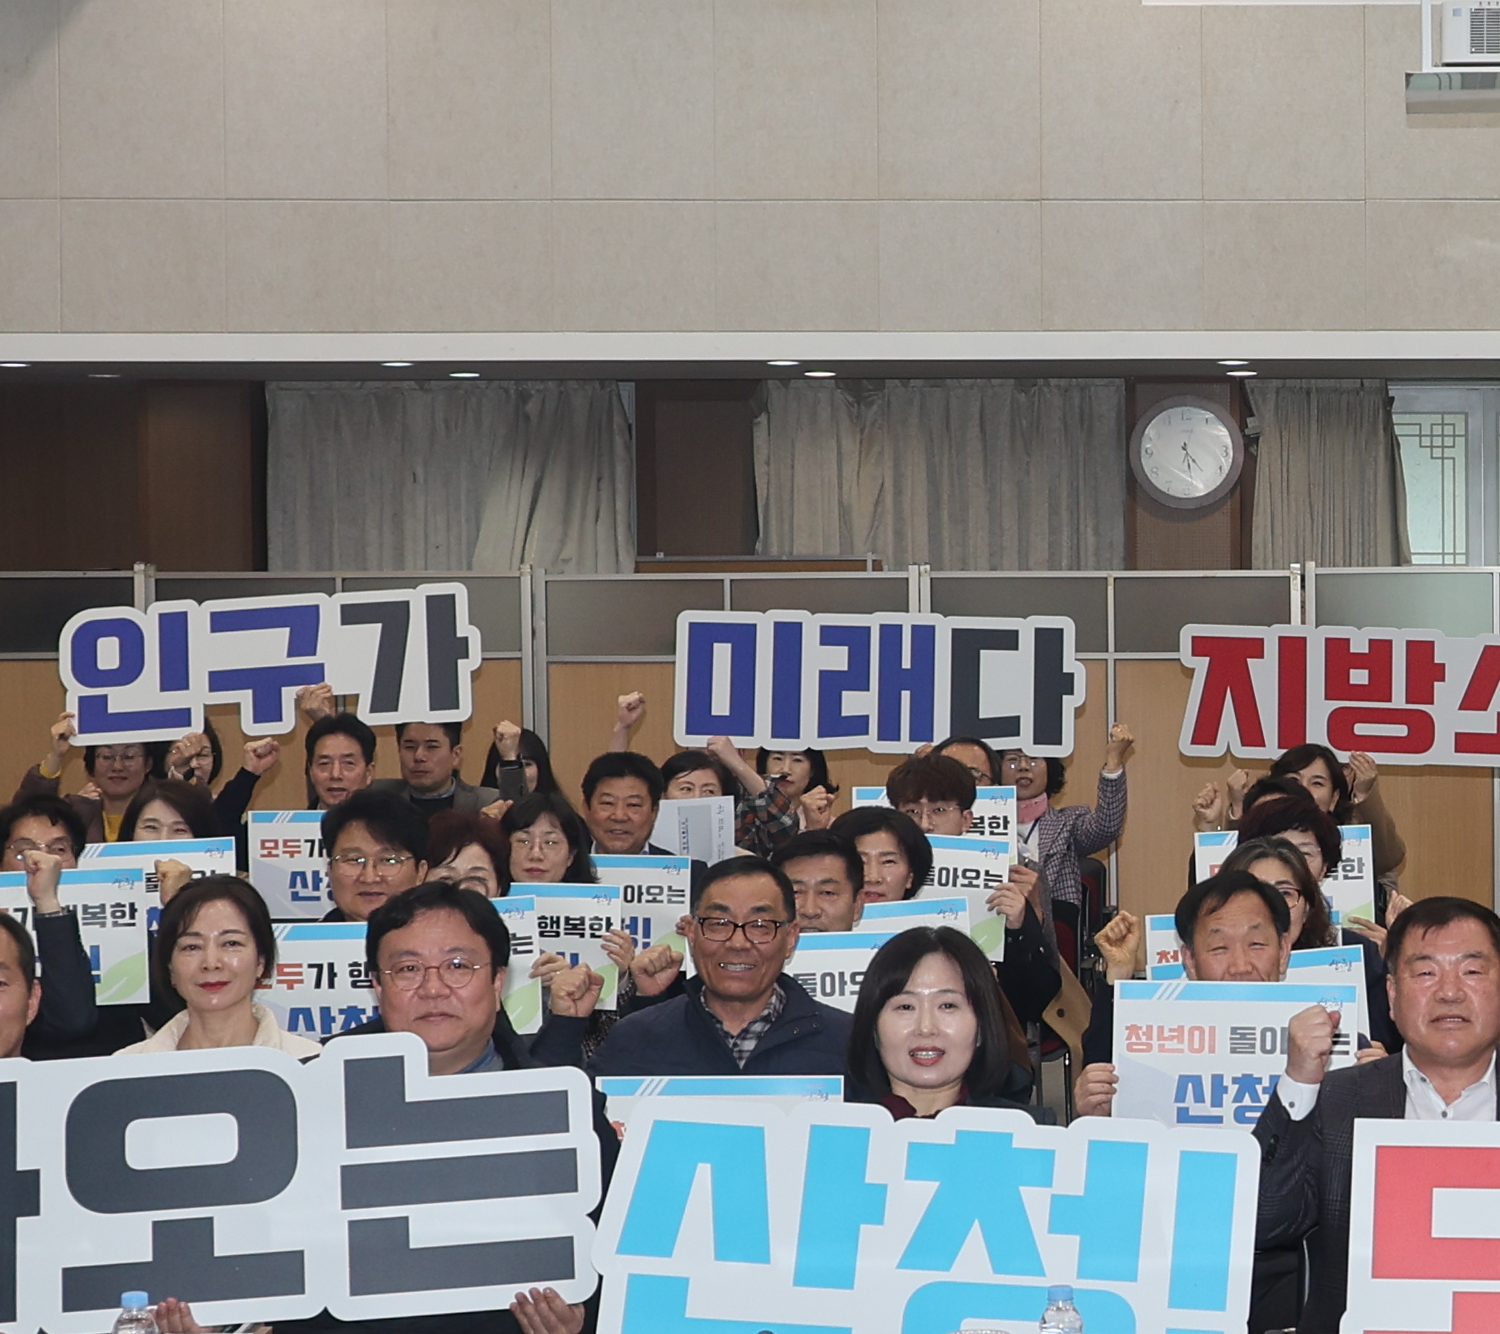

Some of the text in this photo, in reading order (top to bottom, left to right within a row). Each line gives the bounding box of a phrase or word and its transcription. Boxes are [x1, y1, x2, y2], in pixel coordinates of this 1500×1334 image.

[71, 594, 469, 734] 인구가
[685, 621, 1075, 746] 미래다
[968, 815, 1010, 836] 복한
[623, 883, 686, 905] 아오는
[78, 901, 138, 929] 복한
[537, 914, 613, 940] 행복한
[1125, 1024, 1216, 1055] 청년이
[1174, 1073, 1280, 1126] 산청
